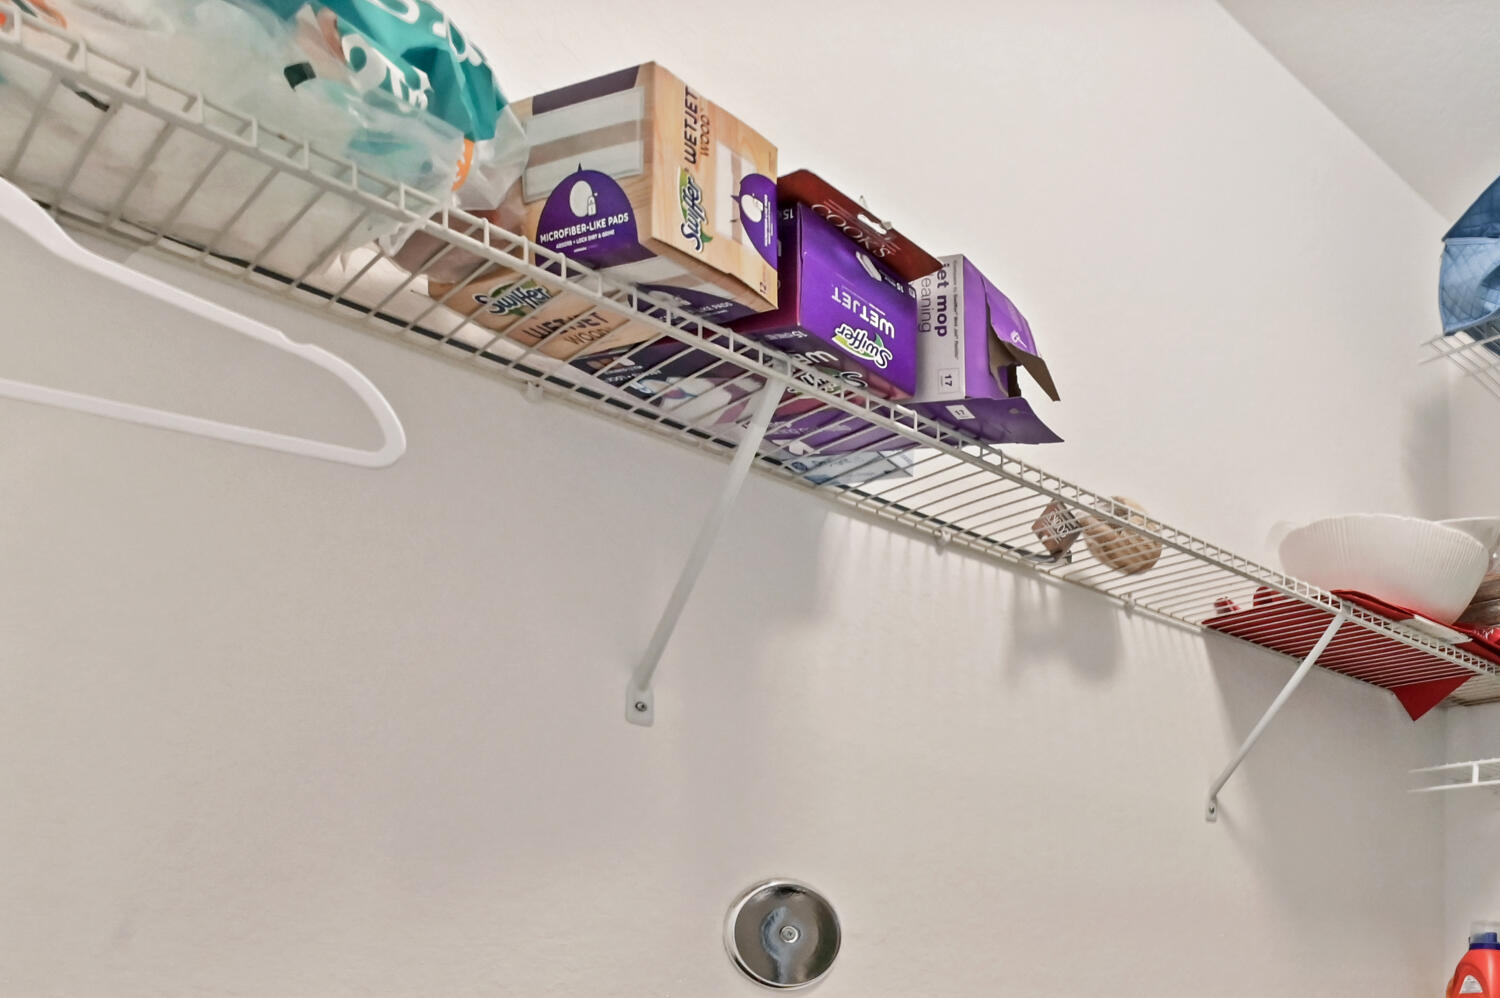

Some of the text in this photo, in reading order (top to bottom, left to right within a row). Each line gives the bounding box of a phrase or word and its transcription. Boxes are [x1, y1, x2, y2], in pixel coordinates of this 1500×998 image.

[683, 85, 699, 165] WETJET
[699, 114, 710, 157] WOOD
[540, 212, 629, 244] MICROFIBER-LIKE PADS
[681, 174, 708, 253] Swiffer
[832, 287, 894, 339] WETJET
[918, 276, 932, 333] eaning
[936, 294, 948, 338] mop
[835, 323, 893, 369] Swiffer
[944, 374, 953, 387] 17
